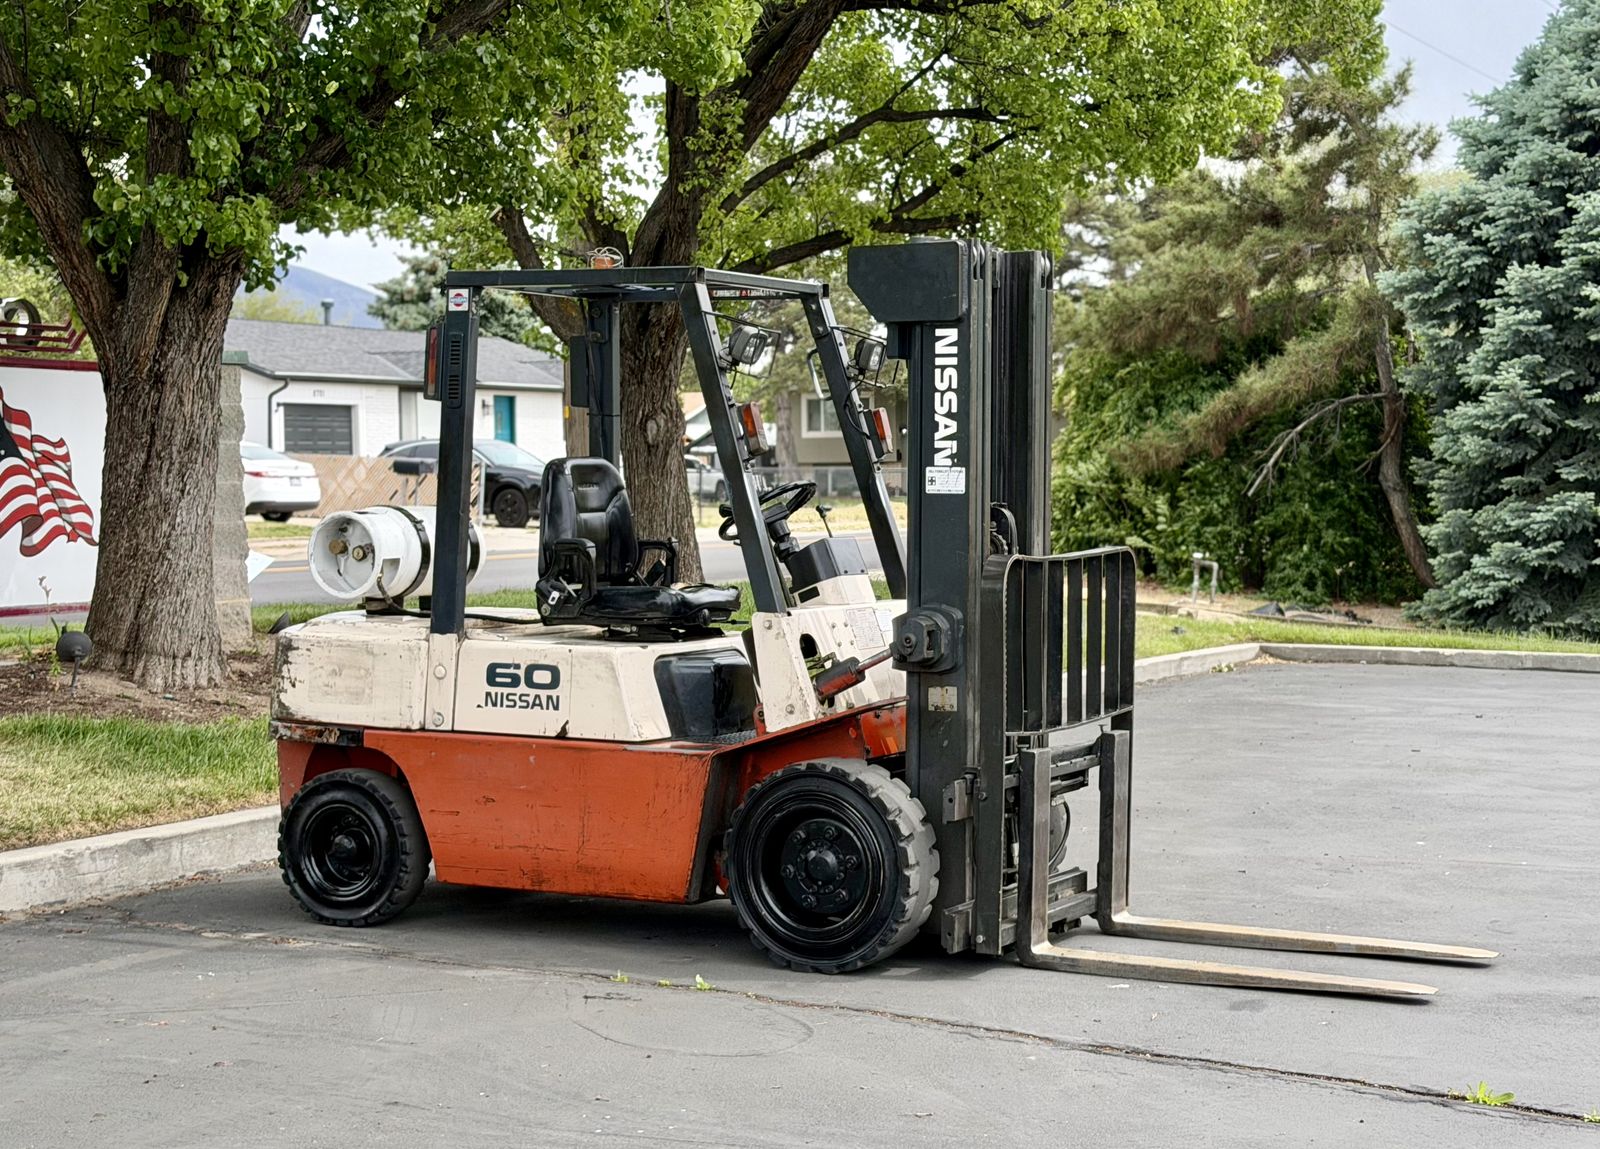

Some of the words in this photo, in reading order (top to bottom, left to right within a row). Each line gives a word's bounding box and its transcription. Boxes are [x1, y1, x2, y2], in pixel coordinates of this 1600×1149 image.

[934, 328, 958, 466] NISSAN
[486, 662, 561, 690] 60
[484, 691, 560, 711] NISSAN
